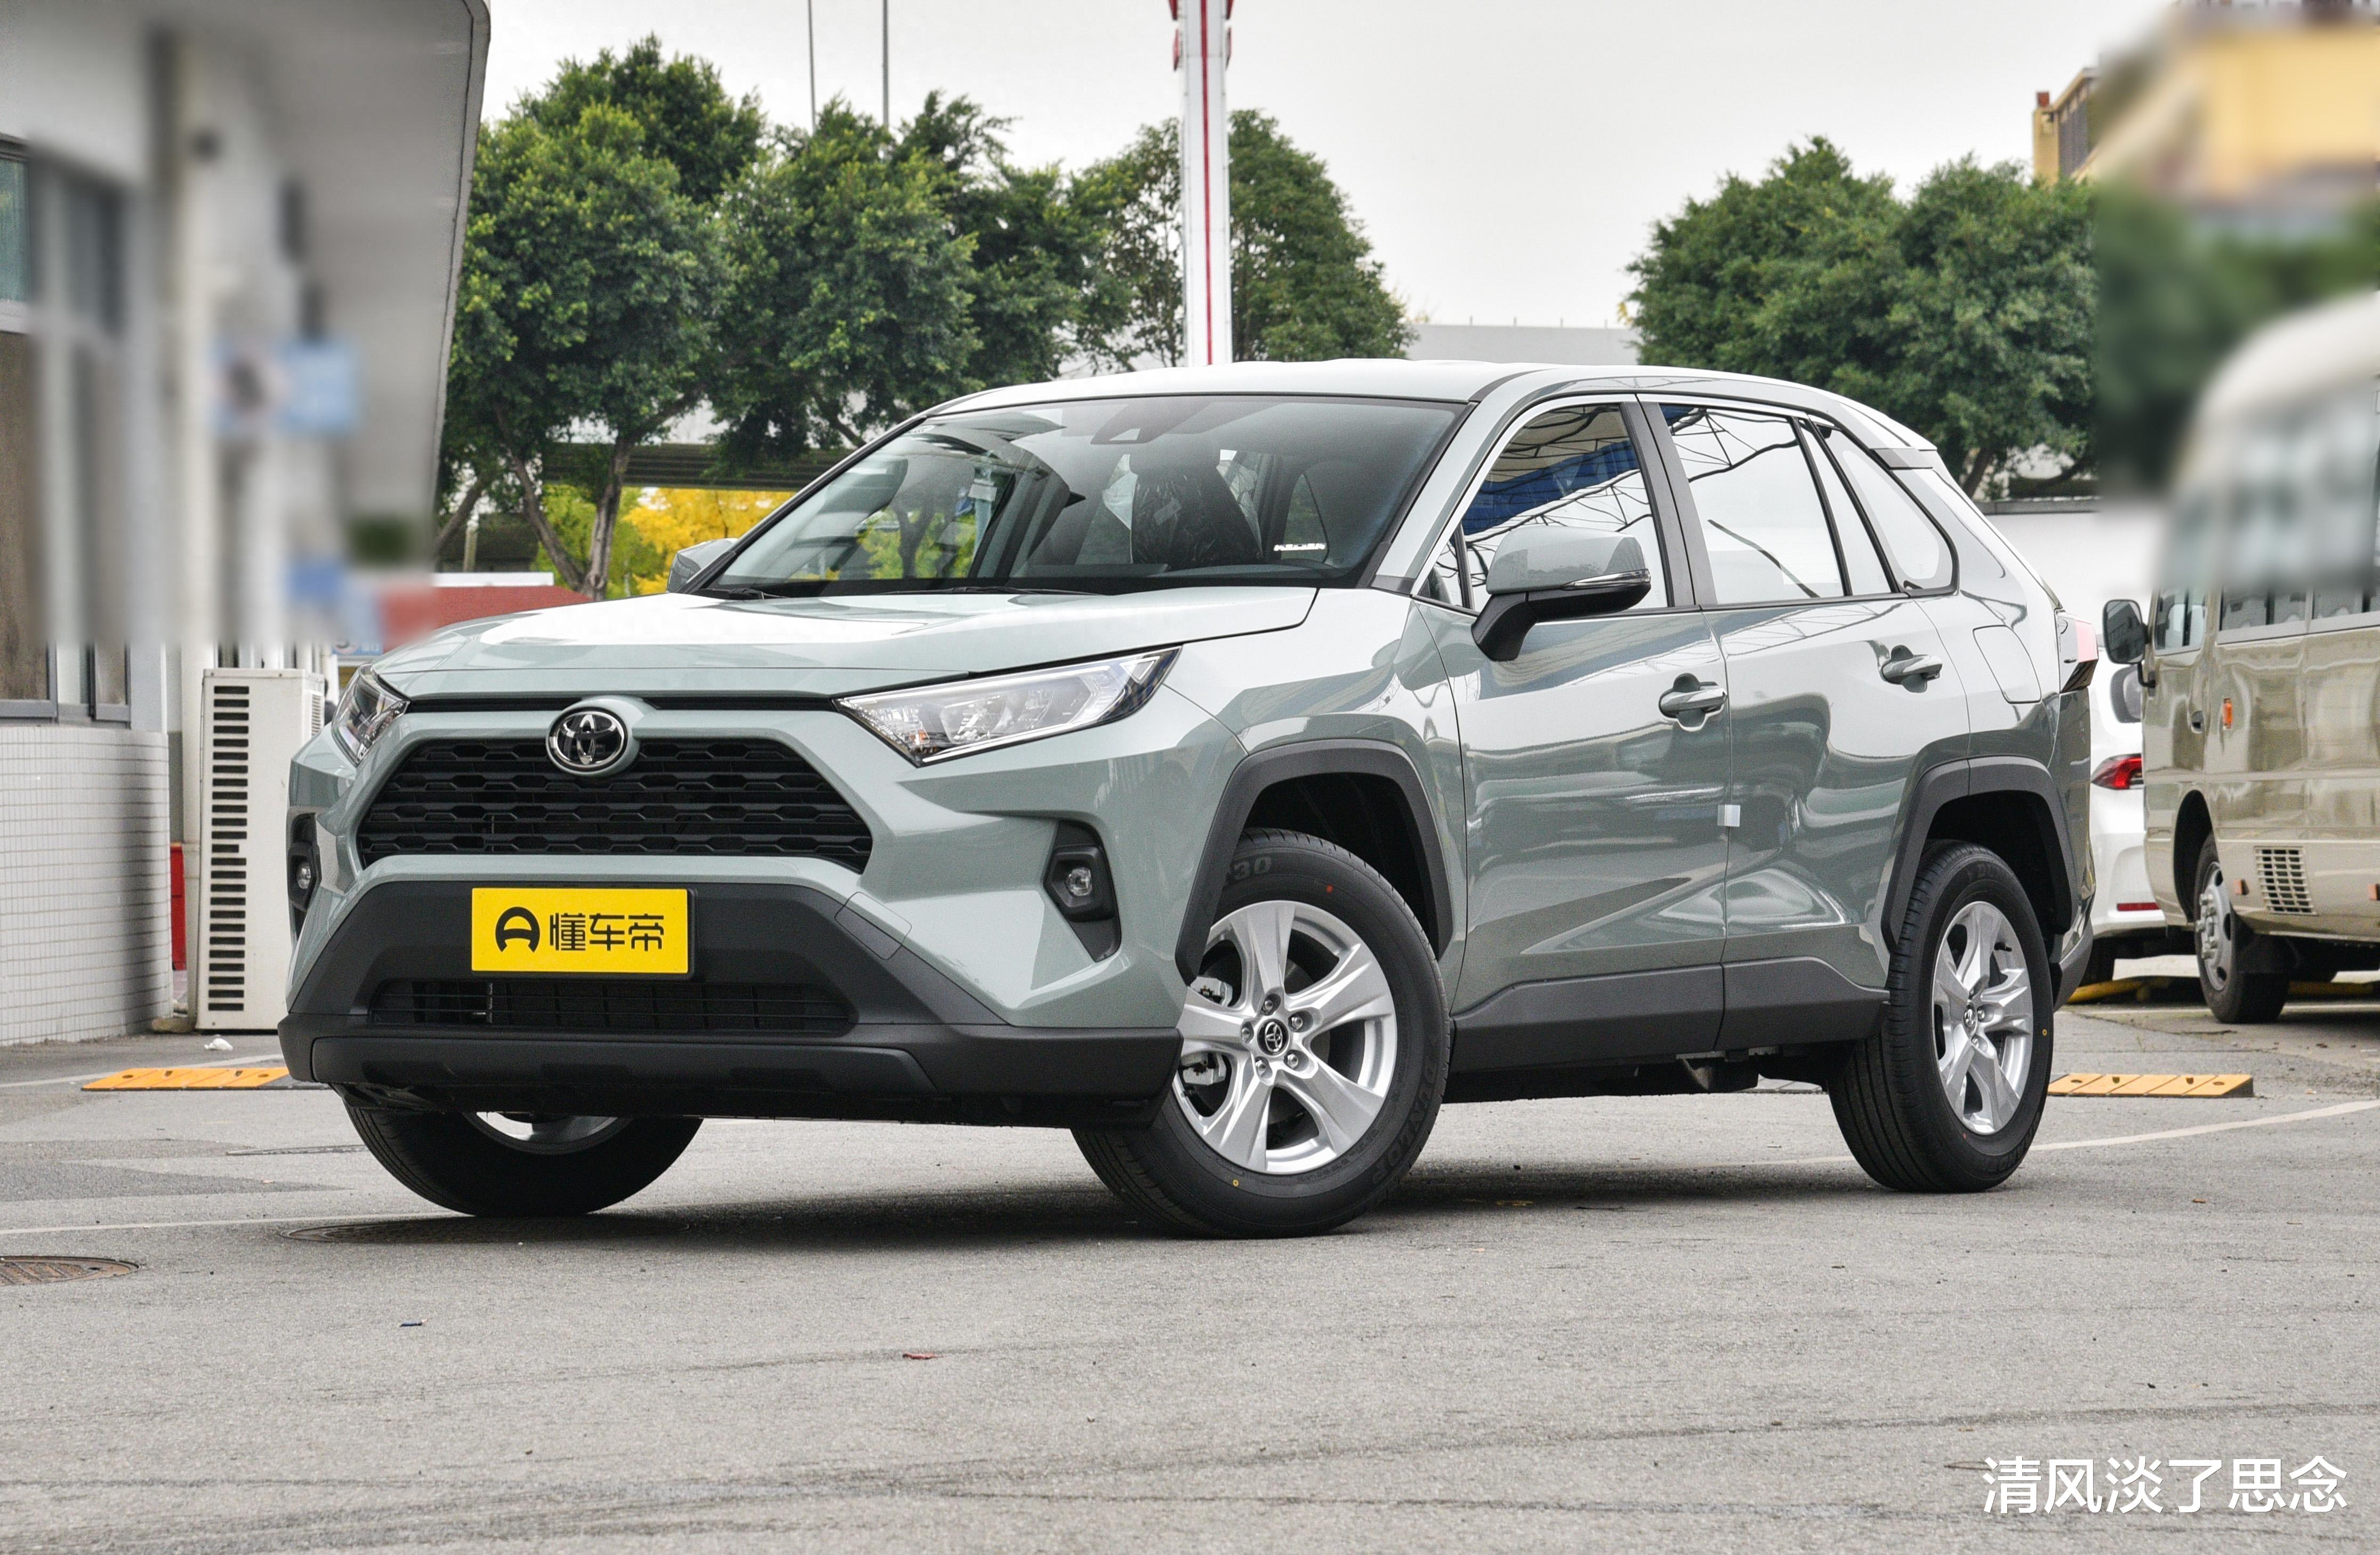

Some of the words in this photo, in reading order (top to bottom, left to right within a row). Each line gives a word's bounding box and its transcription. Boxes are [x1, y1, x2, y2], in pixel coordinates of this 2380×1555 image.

[1231, 855, 1273, 882] 30
[549, 912, 664, 952] 懂车帝
[1372, 1055, 1438, 1185] DUNLOP
